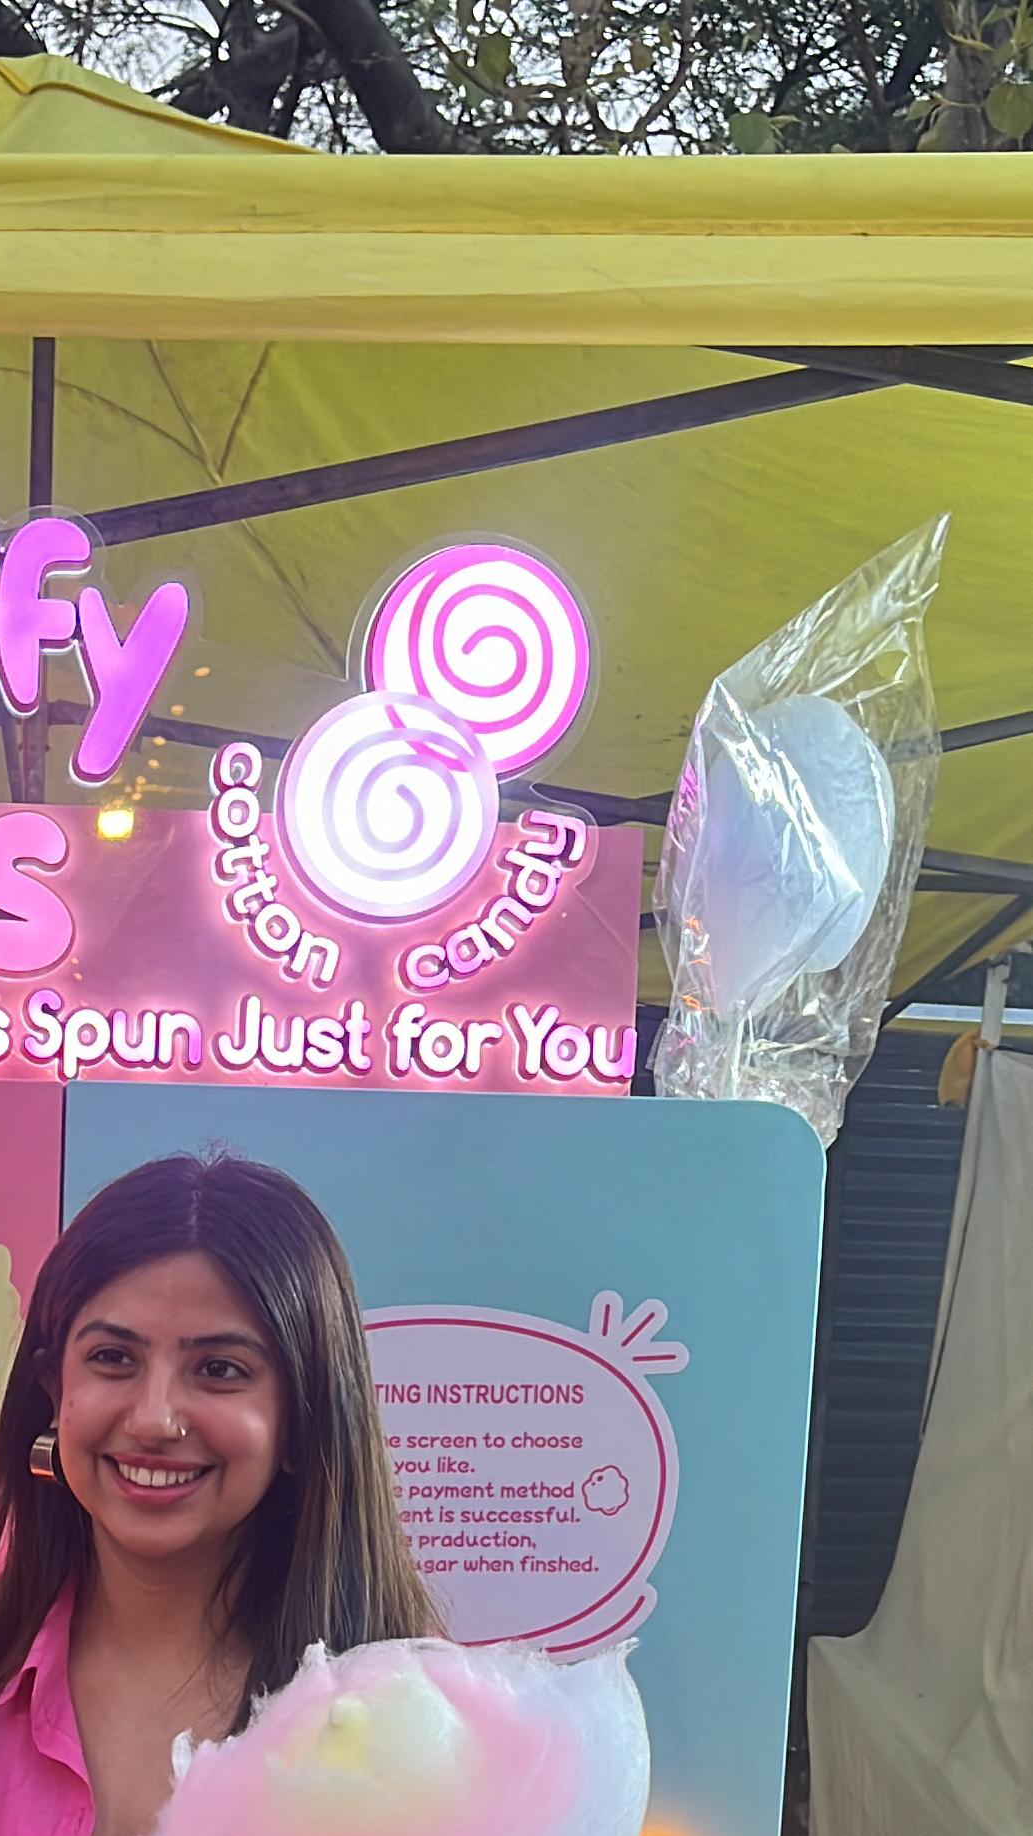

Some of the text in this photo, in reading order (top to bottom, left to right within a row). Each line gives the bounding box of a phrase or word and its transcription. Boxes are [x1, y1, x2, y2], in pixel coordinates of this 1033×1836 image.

[215, 742, 588, 990] cotton candy
[24, 988, 203, 1080] Spun
[217, 995, 371, 1074] Just
[390, 1002, 503, 1076] for
[511, 1003, 637, 1080] You
[374, 1384, 584, 1405] TING INSTRUCTIONS
[406, 1434, 477, 1449] screen
[482, 1433, 506, 1449] to
[511, 1432, 584, 1449] choose
[394, 1457, 475, 1475] you like.
[408, 1482, 495, 1501] payment
[500, 1481, 575, 1499] method
[439, 1507, 456, 1523] is
[460, 1506, 581, 1524] successful.
[414, 1555, 600, 1575] ugar when finshed.
